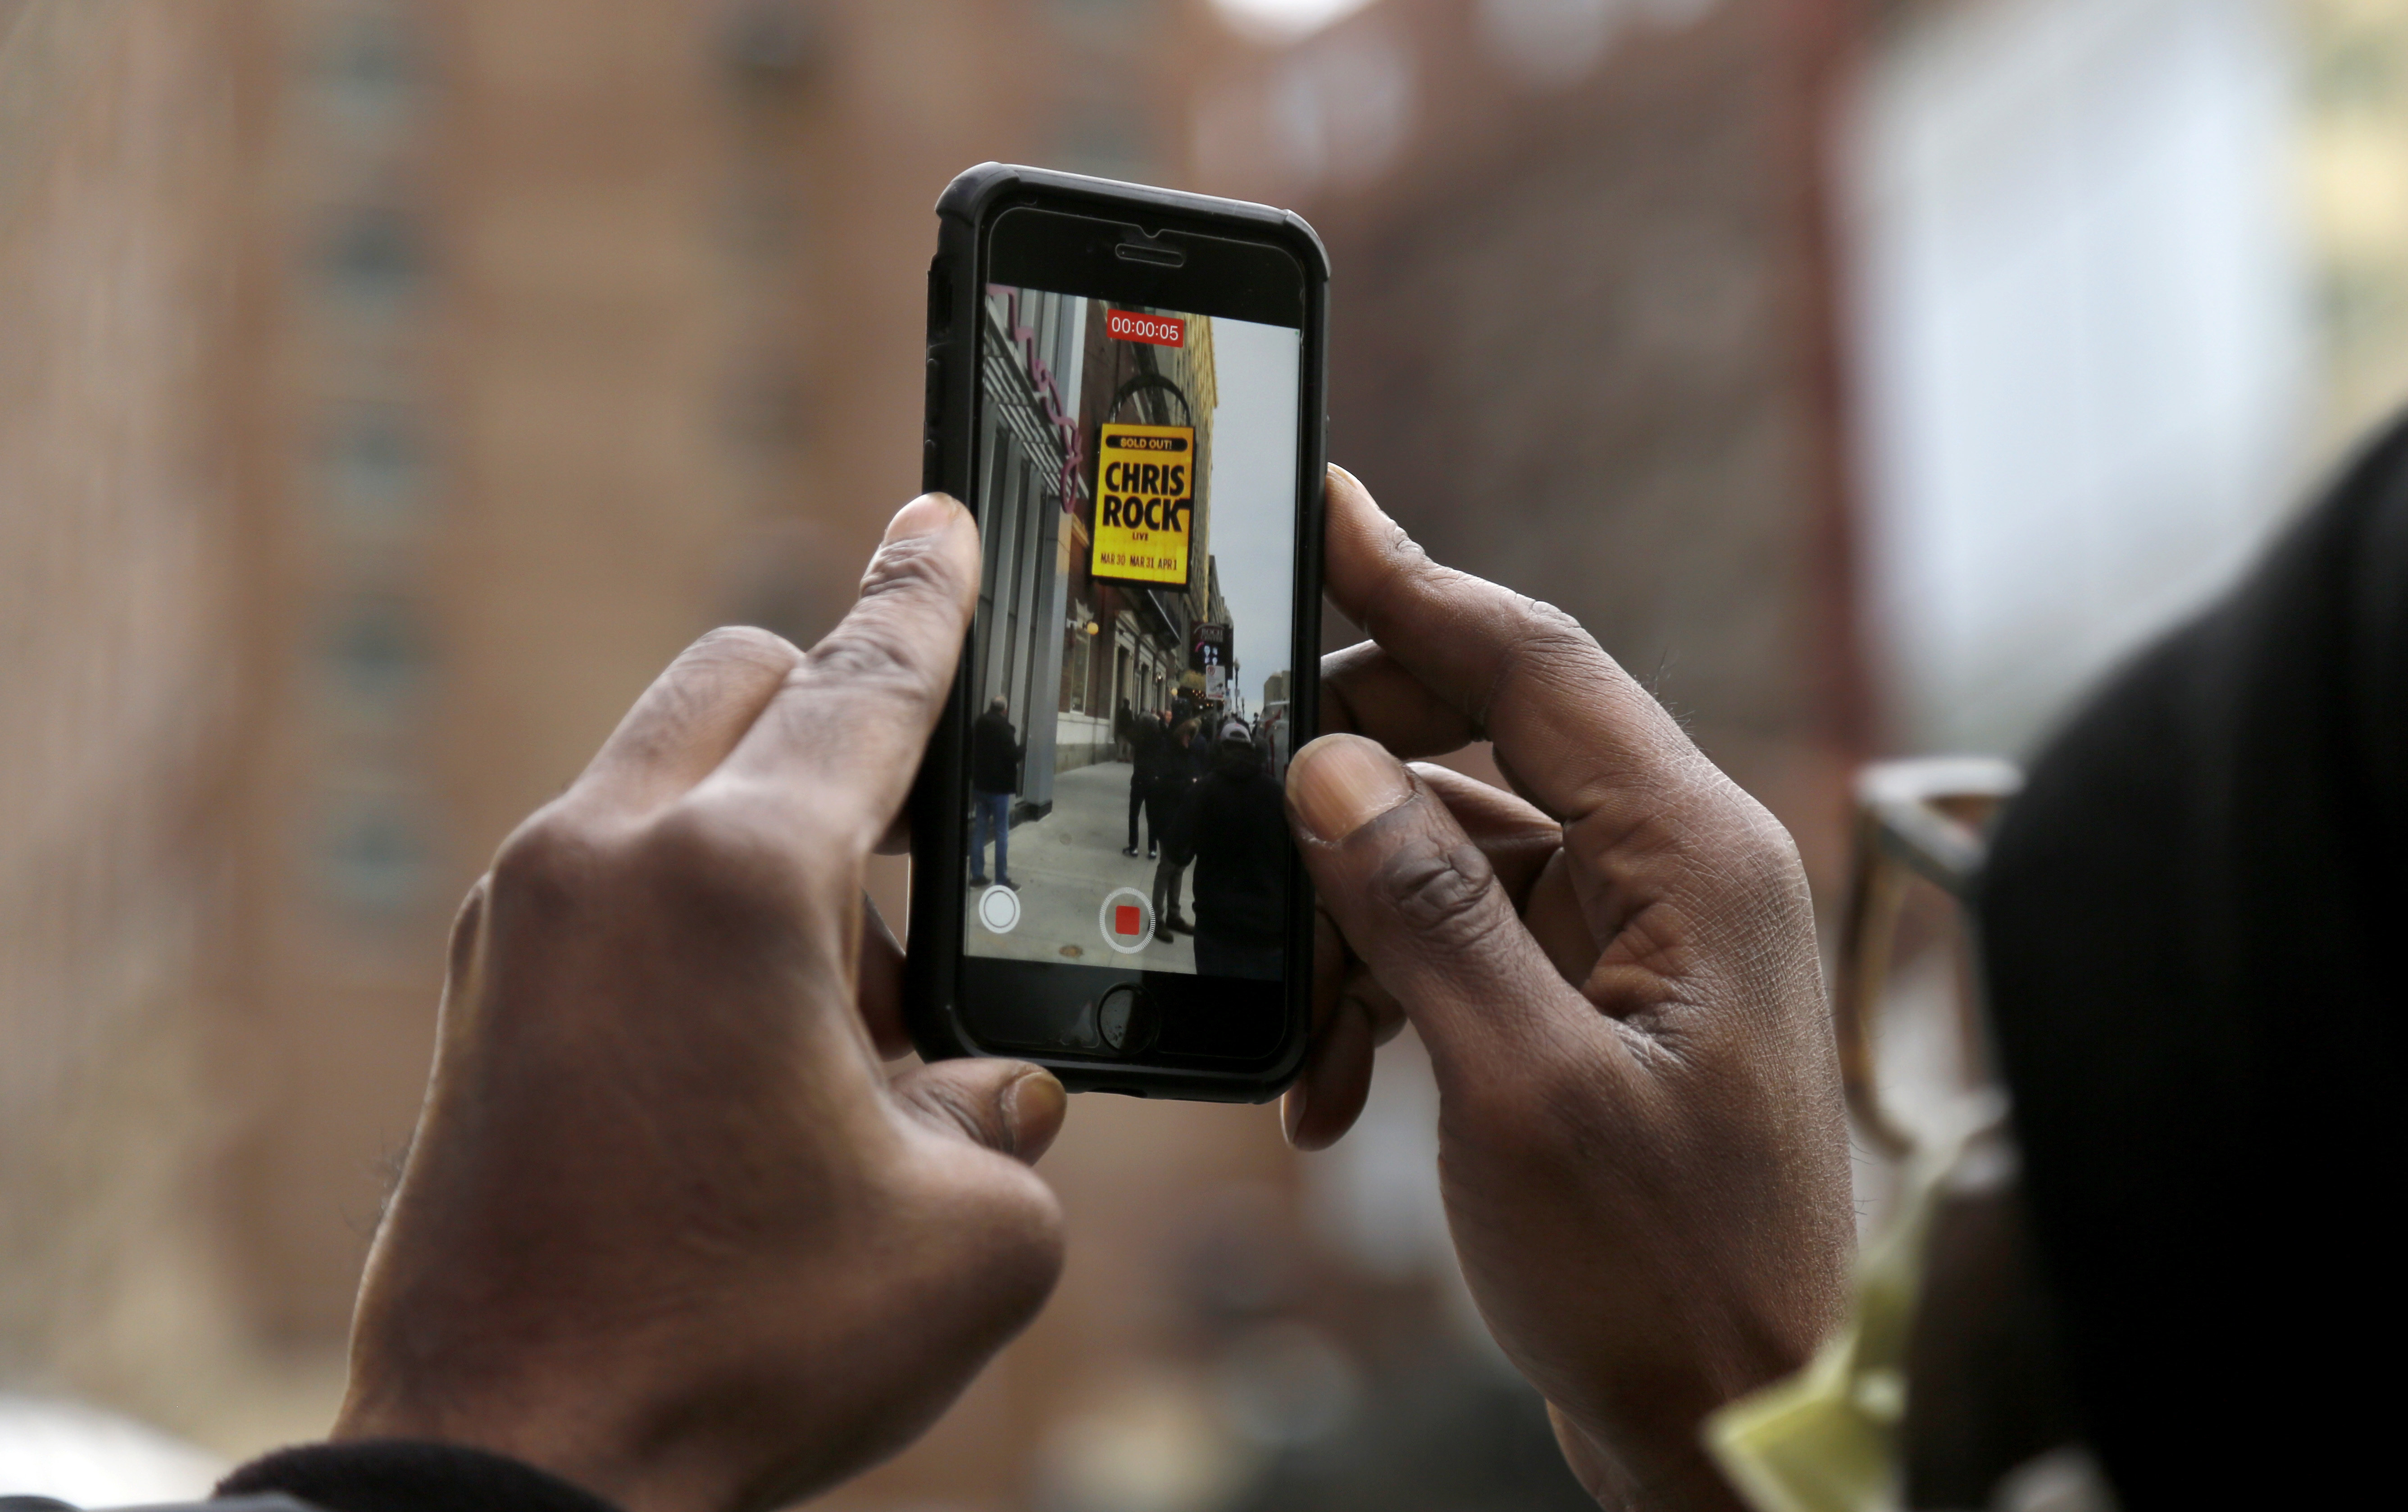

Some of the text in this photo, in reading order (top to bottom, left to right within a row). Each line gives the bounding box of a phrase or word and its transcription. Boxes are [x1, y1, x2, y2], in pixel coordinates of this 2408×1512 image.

[1112, 317, 1179, 341] 00:00:05
[1121, 437, 1172, 450] SOLD OUT!
[1106, 461, 1184, 496] CHRIS
[1103, 495, 1183, 533] ROCK
[1133, 532, 1148, 541] LIVE
[1101, 552, 1115, 564] MAR
[1117, 555, 1125, 566] 30
[1130, 555, 1144, 567] MAR
[1147, 557, 1154, 568] 31
[1158, 558, 1172, 570] APR
